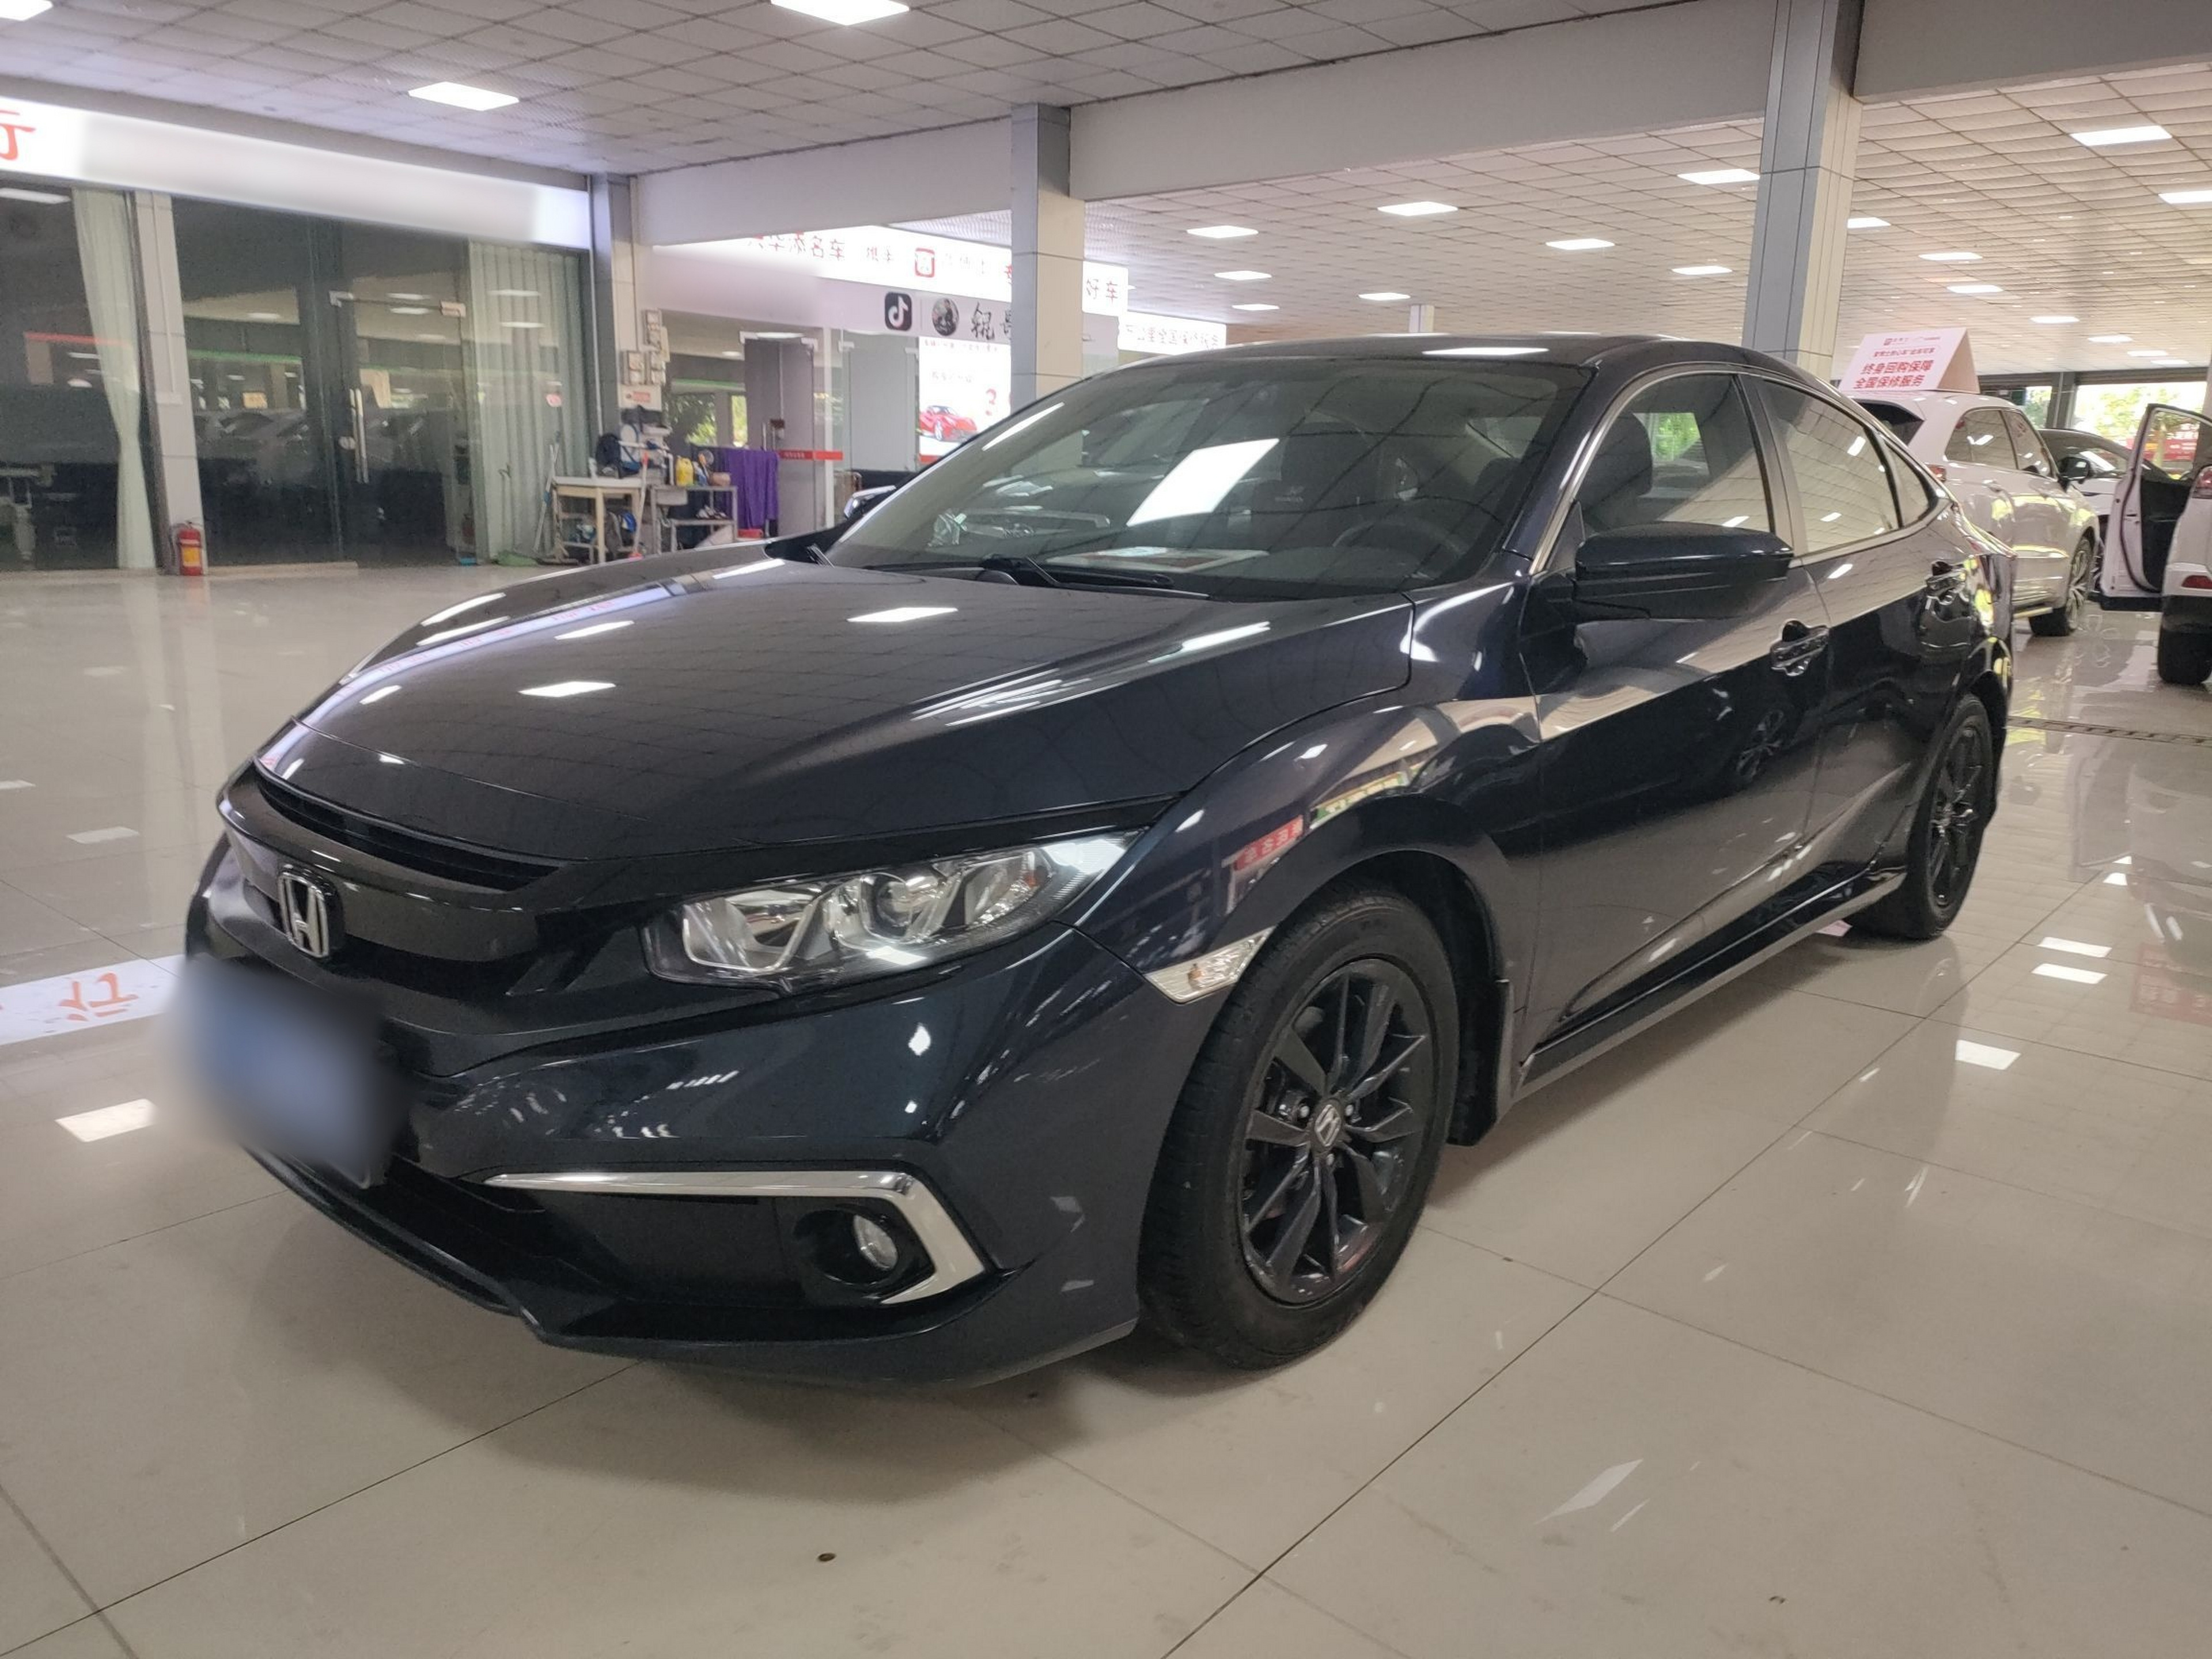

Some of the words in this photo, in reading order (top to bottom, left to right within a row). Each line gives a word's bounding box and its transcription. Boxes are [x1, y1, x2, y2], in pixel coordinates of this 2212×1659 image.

[1861, 360, 1934, 374] 终身回购保障
[1853, 374, 1925, 389] 全国保修服务
